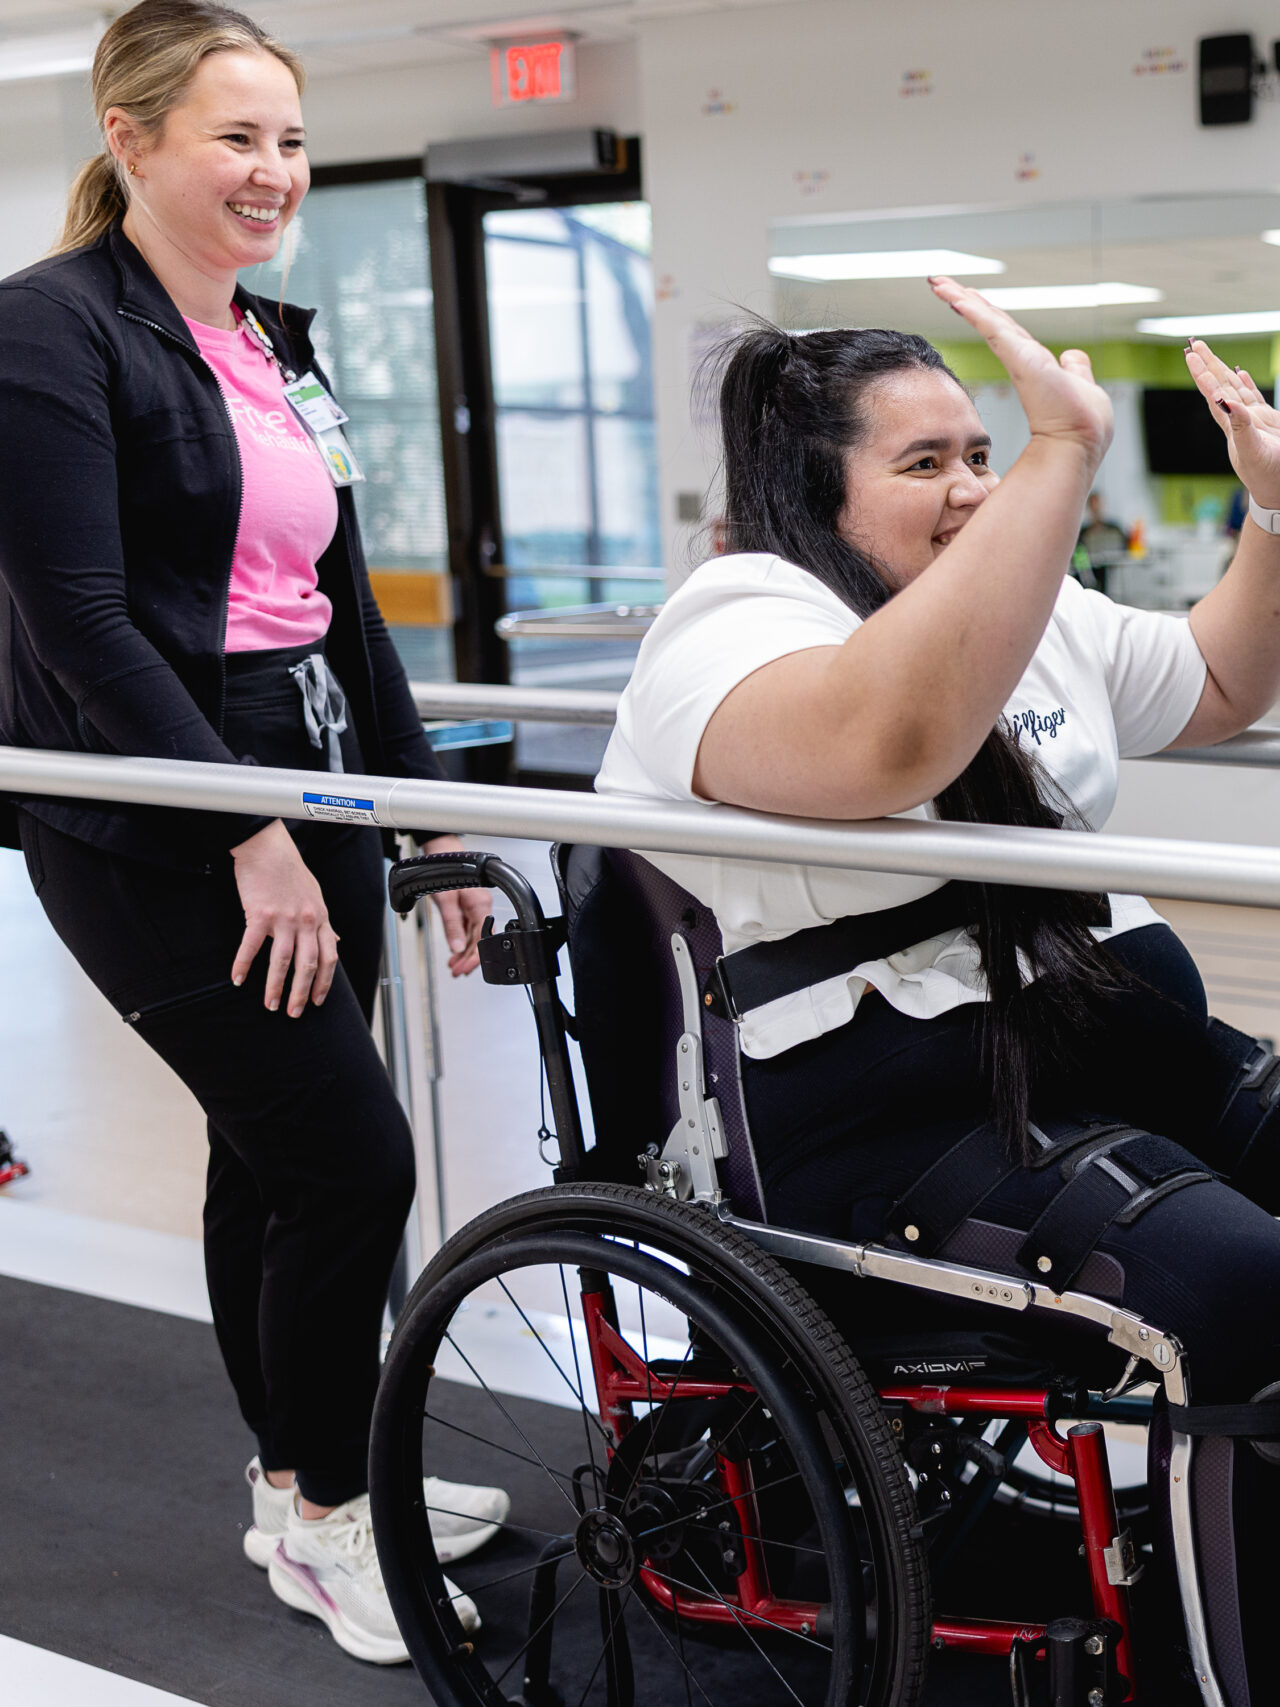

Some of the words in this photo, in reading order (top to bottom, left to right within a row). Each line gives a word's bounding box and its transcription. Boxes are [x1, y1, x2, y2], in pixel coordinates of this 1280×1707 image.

[506, 42, 563, 101] EXIT
[1012, 707, 1066, 745] ilfiger
[321, 796, 356, 807] ATTENTION
